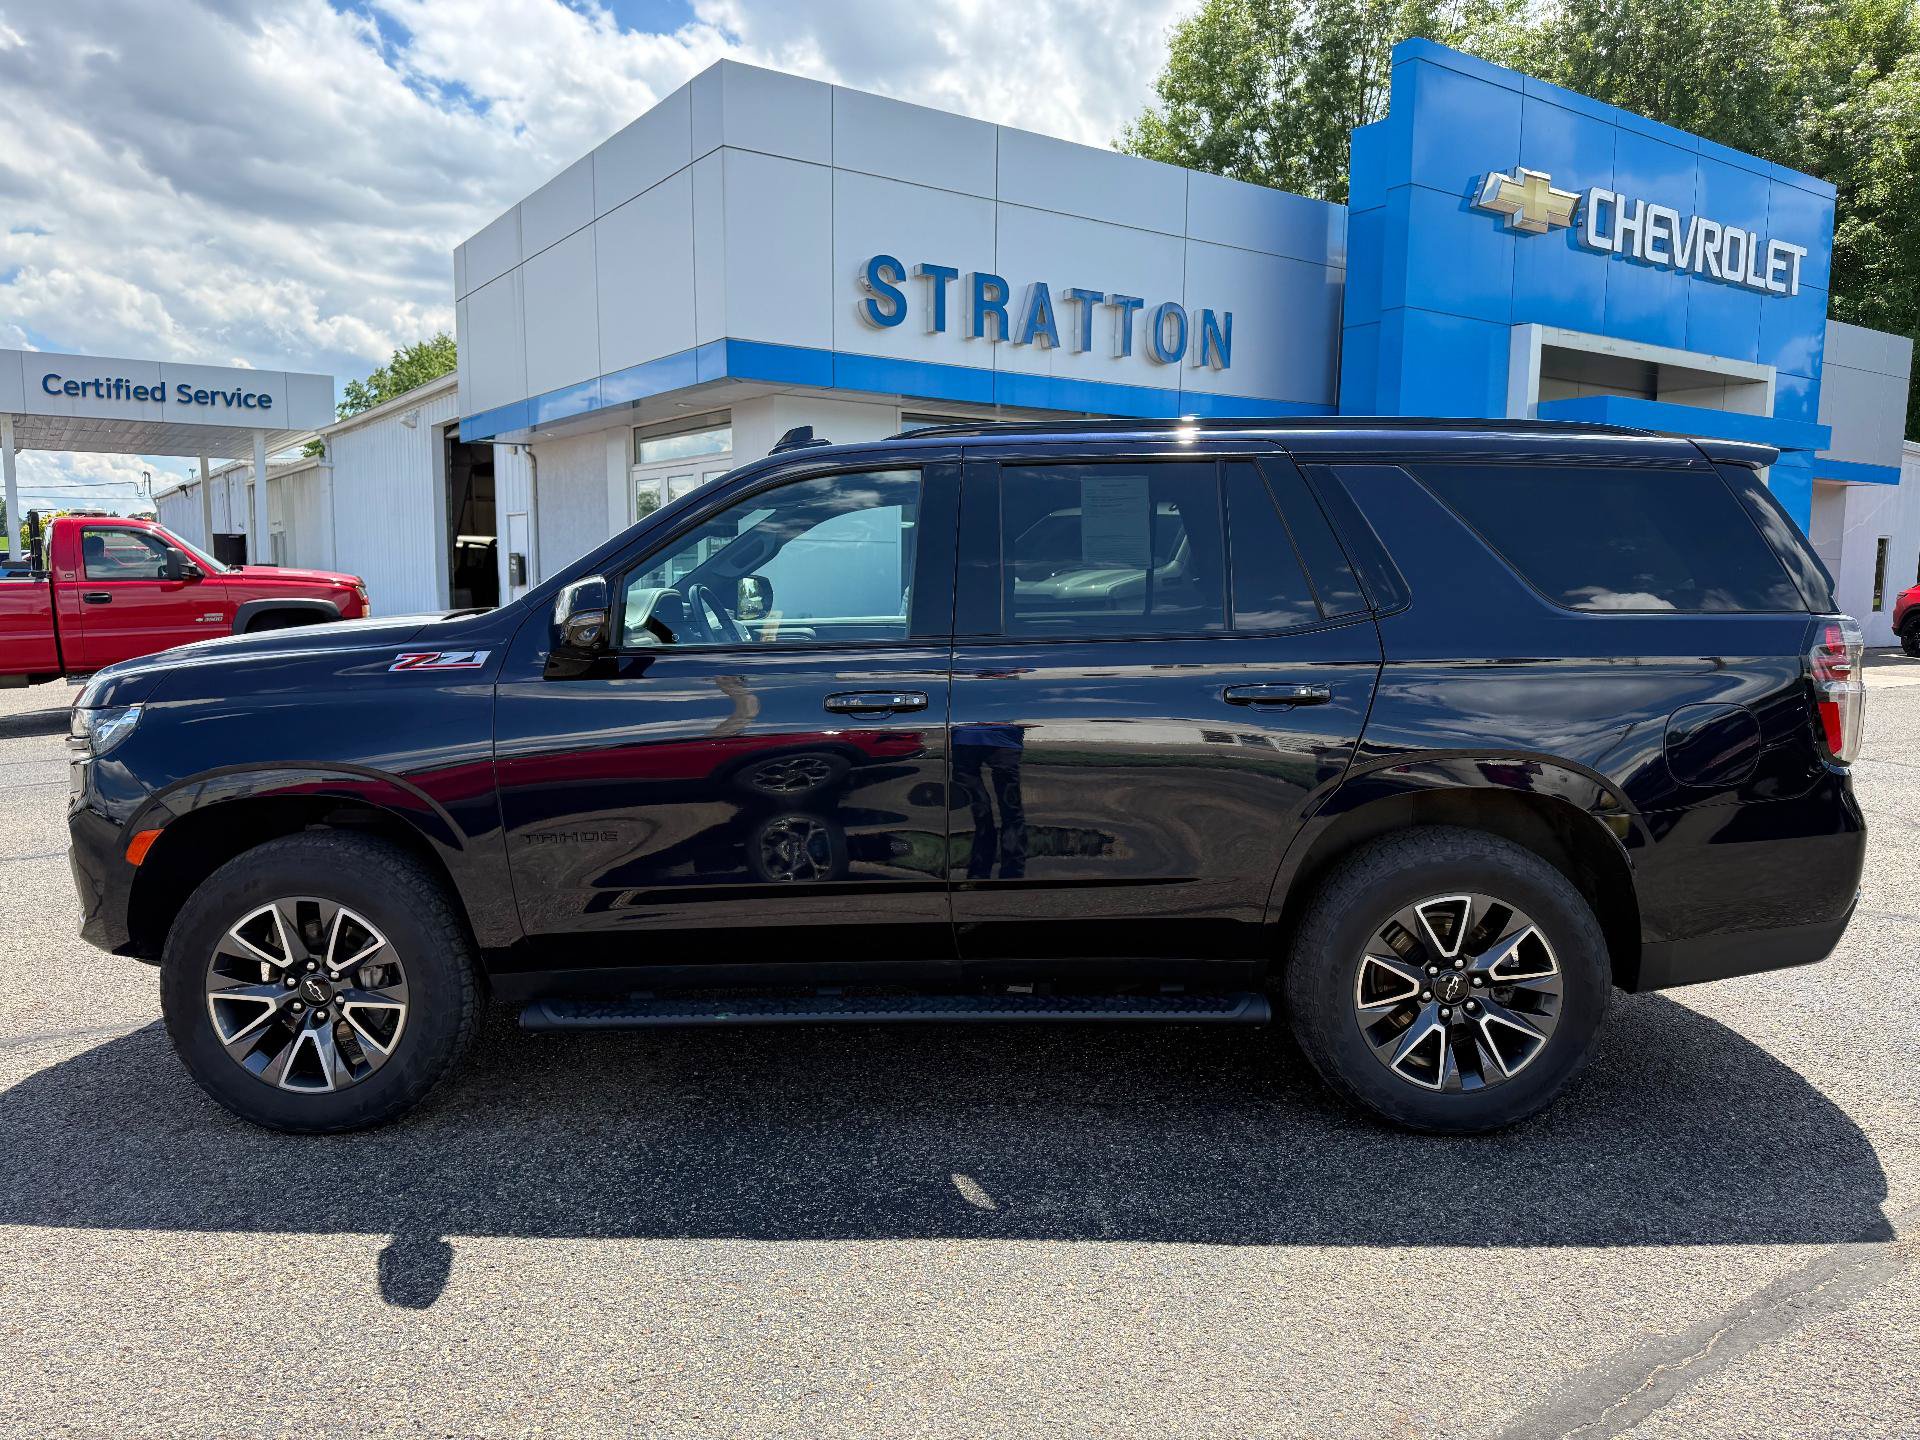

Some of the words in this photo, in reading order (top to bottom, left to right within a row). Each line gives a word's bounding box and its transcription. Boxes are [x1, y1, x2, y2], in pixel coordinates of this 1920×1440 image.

[1580, 187, 1807, 296] CHEVROLET
[857, 254, 1233, 370] STRATTON
[42, 373, 166, 402] Certified
[177, 383, 273, 409] Service
[388, 650, 492, 672] Z71
[521, 831, 618, 845] TAHOE
